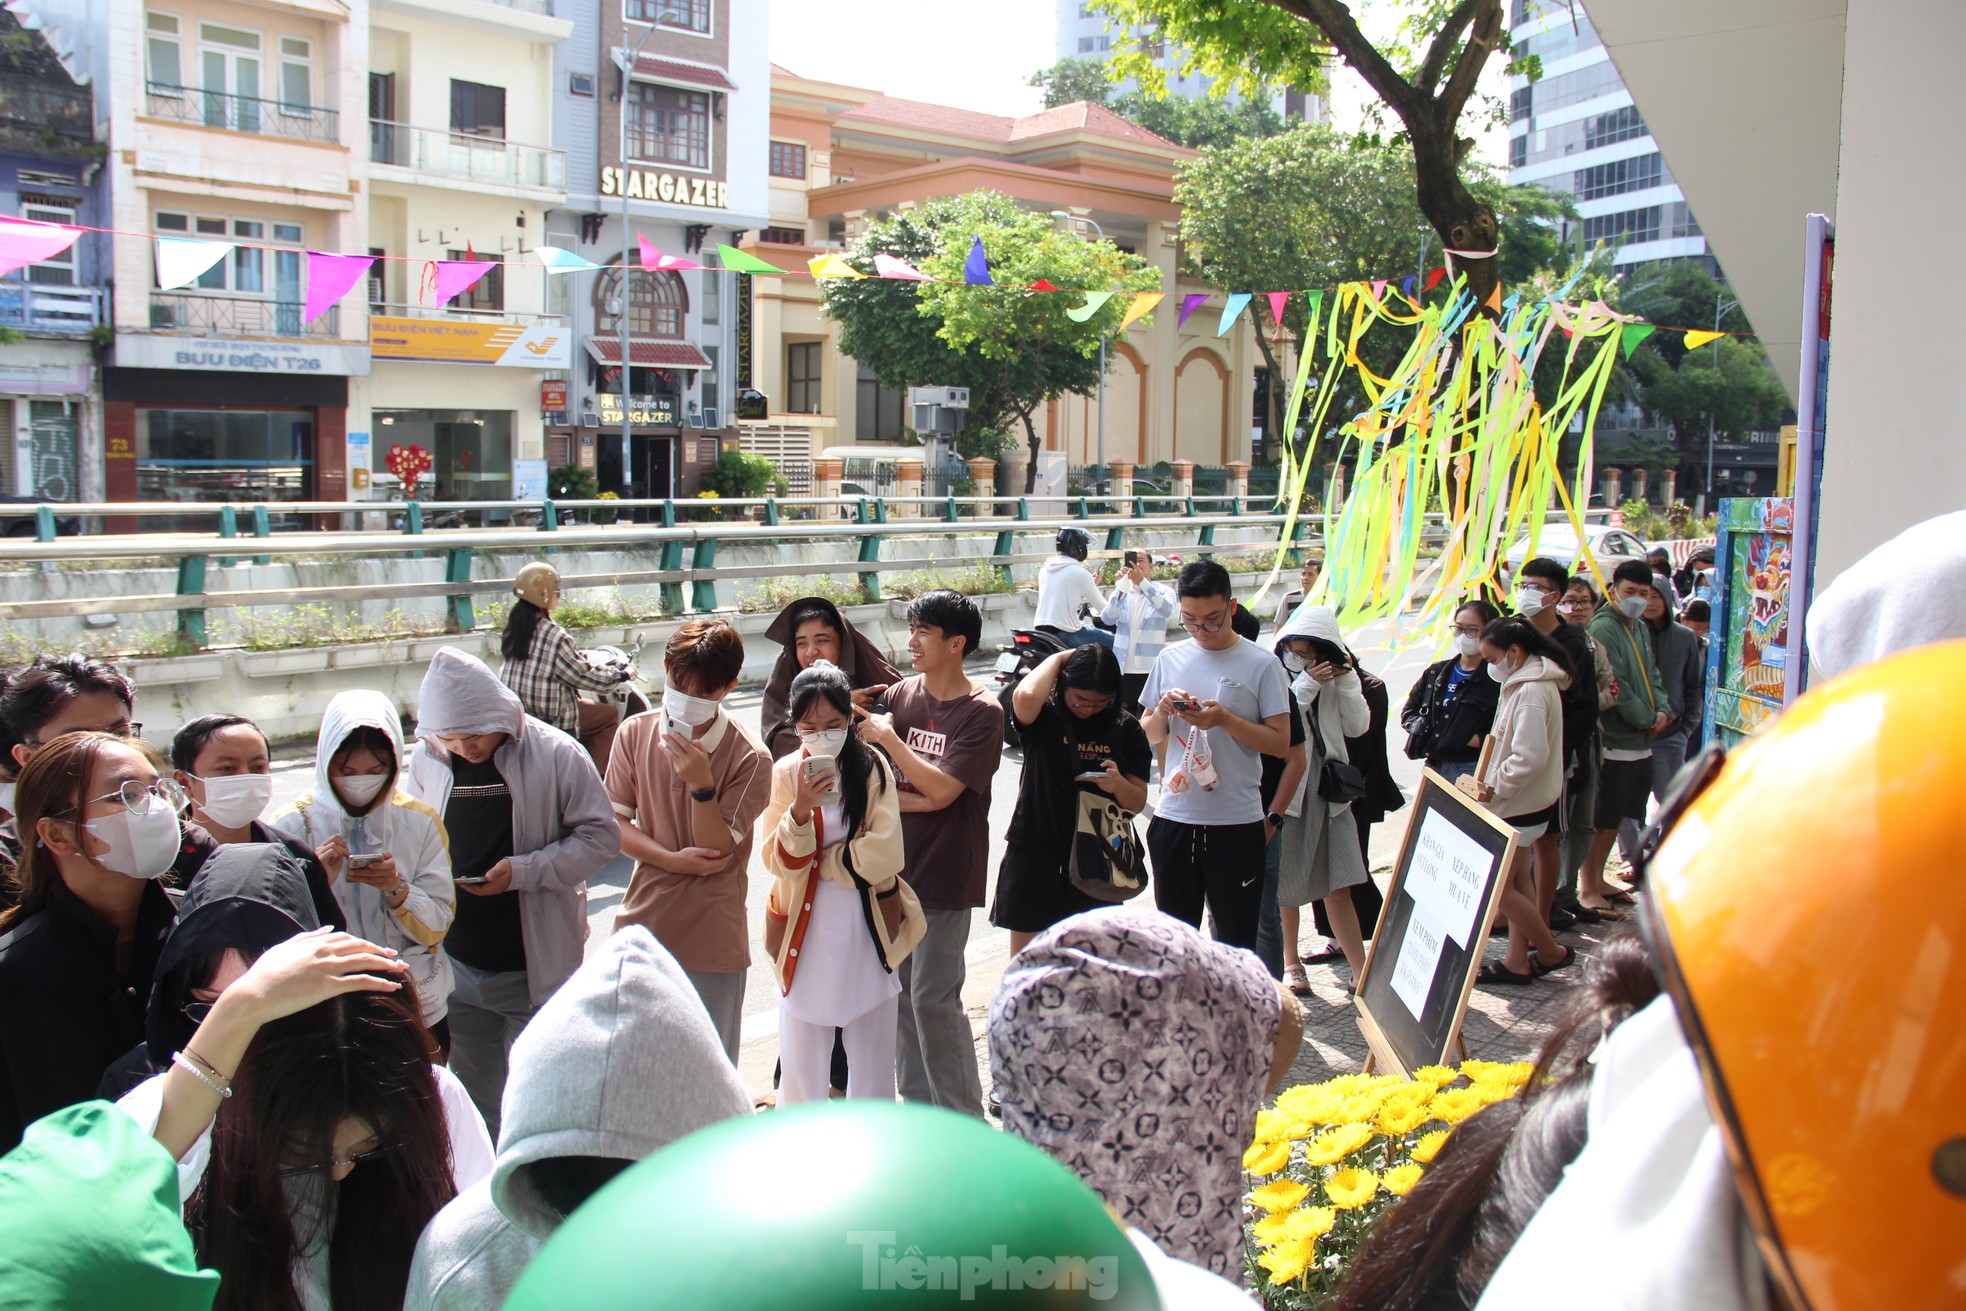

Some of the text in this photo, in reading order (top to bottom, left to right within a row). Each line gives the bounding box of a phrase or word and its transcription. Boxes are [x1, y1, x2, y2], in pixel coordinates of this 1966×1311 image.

[601, 166, 728, 208] STARGAZER
[453, 328, 479, 337] NAM
[229, 352, 278, 370] ĐIỆN
[283, 356, 321, 370] T26
[615, 398, 670, 409] Wlcome to
[909, 731, 943, 753] KITH
